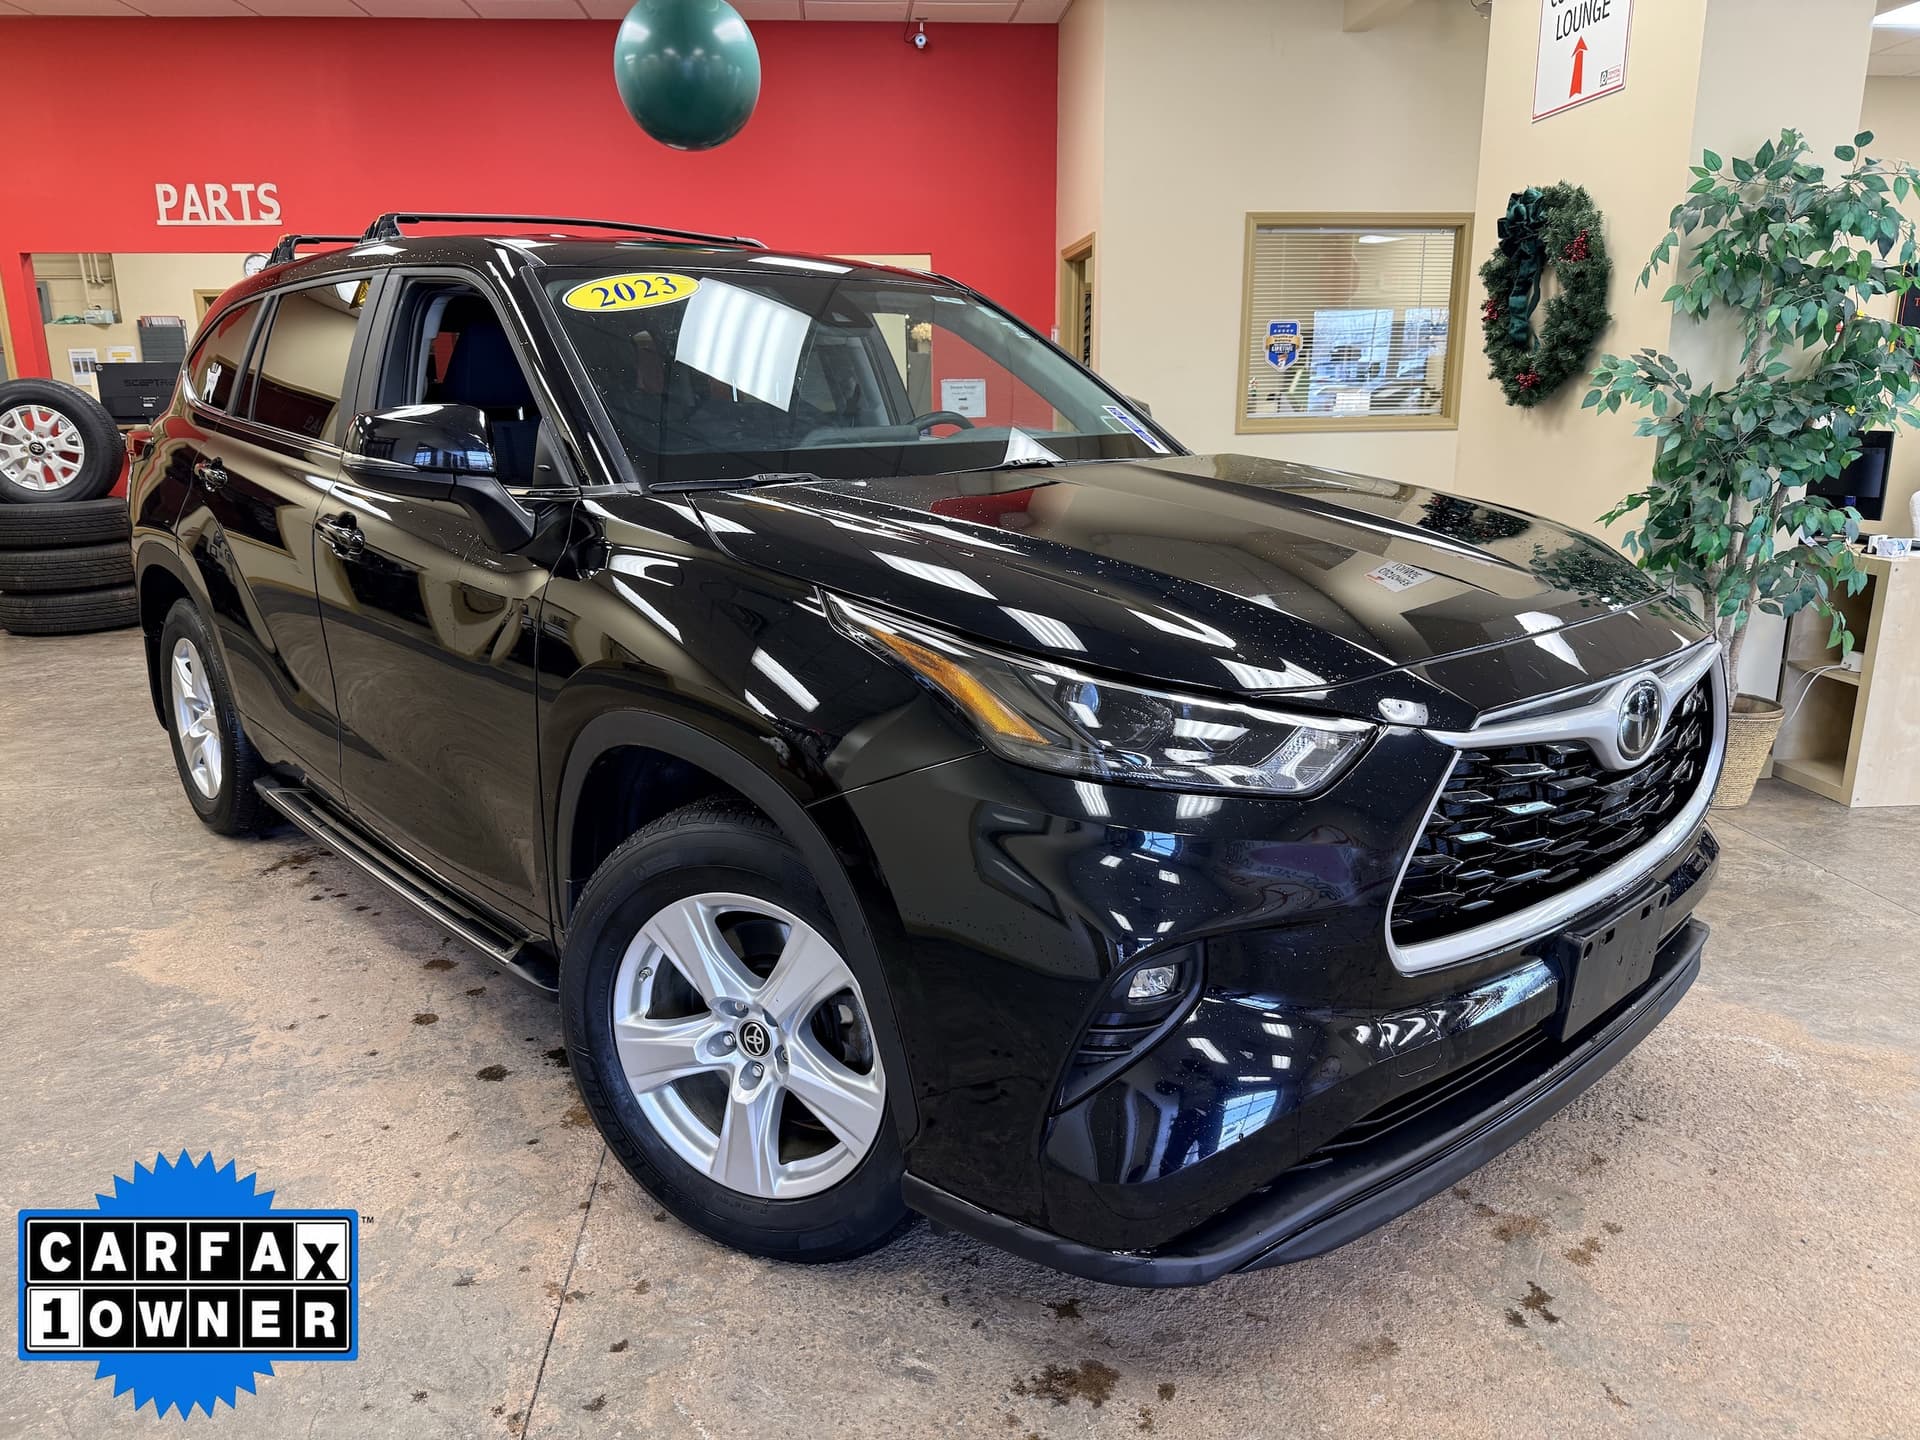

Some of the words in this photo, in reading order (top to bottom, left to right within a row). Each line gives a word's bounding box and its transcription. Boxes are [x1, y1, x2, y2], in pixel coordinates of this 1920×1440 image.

[1556, 0, 1611, 41] LOUNGE
[155, 182, 282, 224] PARTS
[591, 276, 678, 307] 2023
